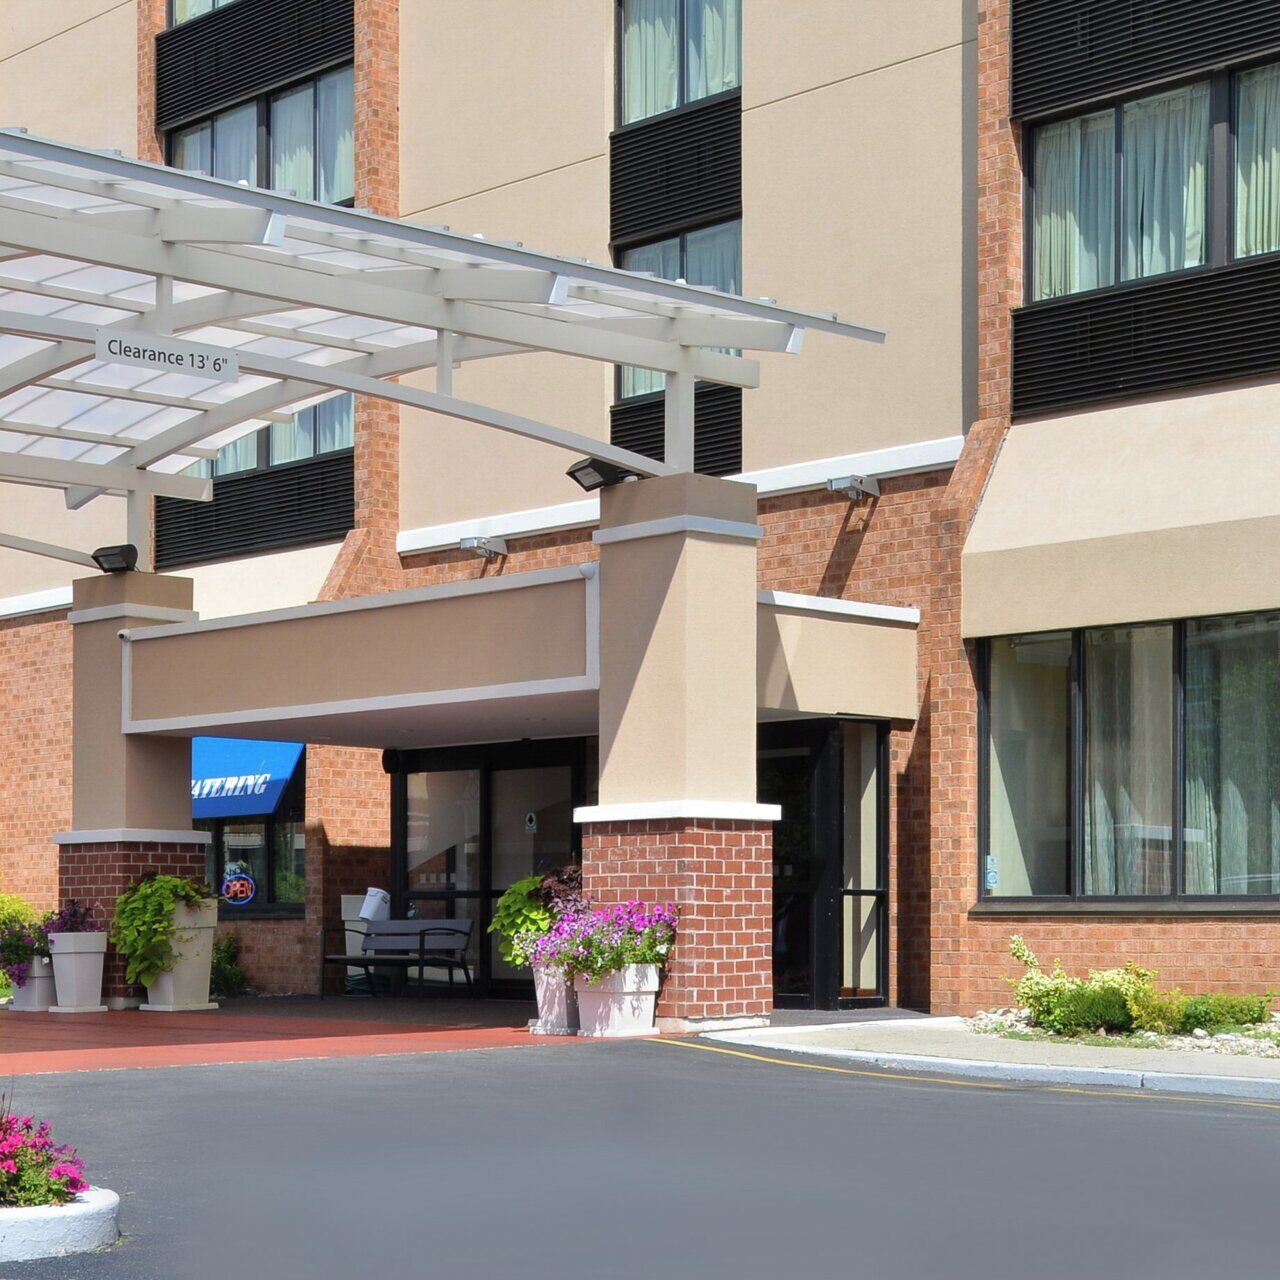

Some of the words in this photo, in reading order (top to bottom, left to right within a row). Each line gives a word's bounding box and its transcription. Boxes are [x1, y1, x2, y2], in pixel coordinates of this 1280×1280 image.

[108, 339, 184, 366] Clearance
[189, 353, 209, 369] 13'
[213, 357, 228, 372] 6"
[191, 773, 271, 799] ATERING
[224, 880, 251, 898] OPEN
